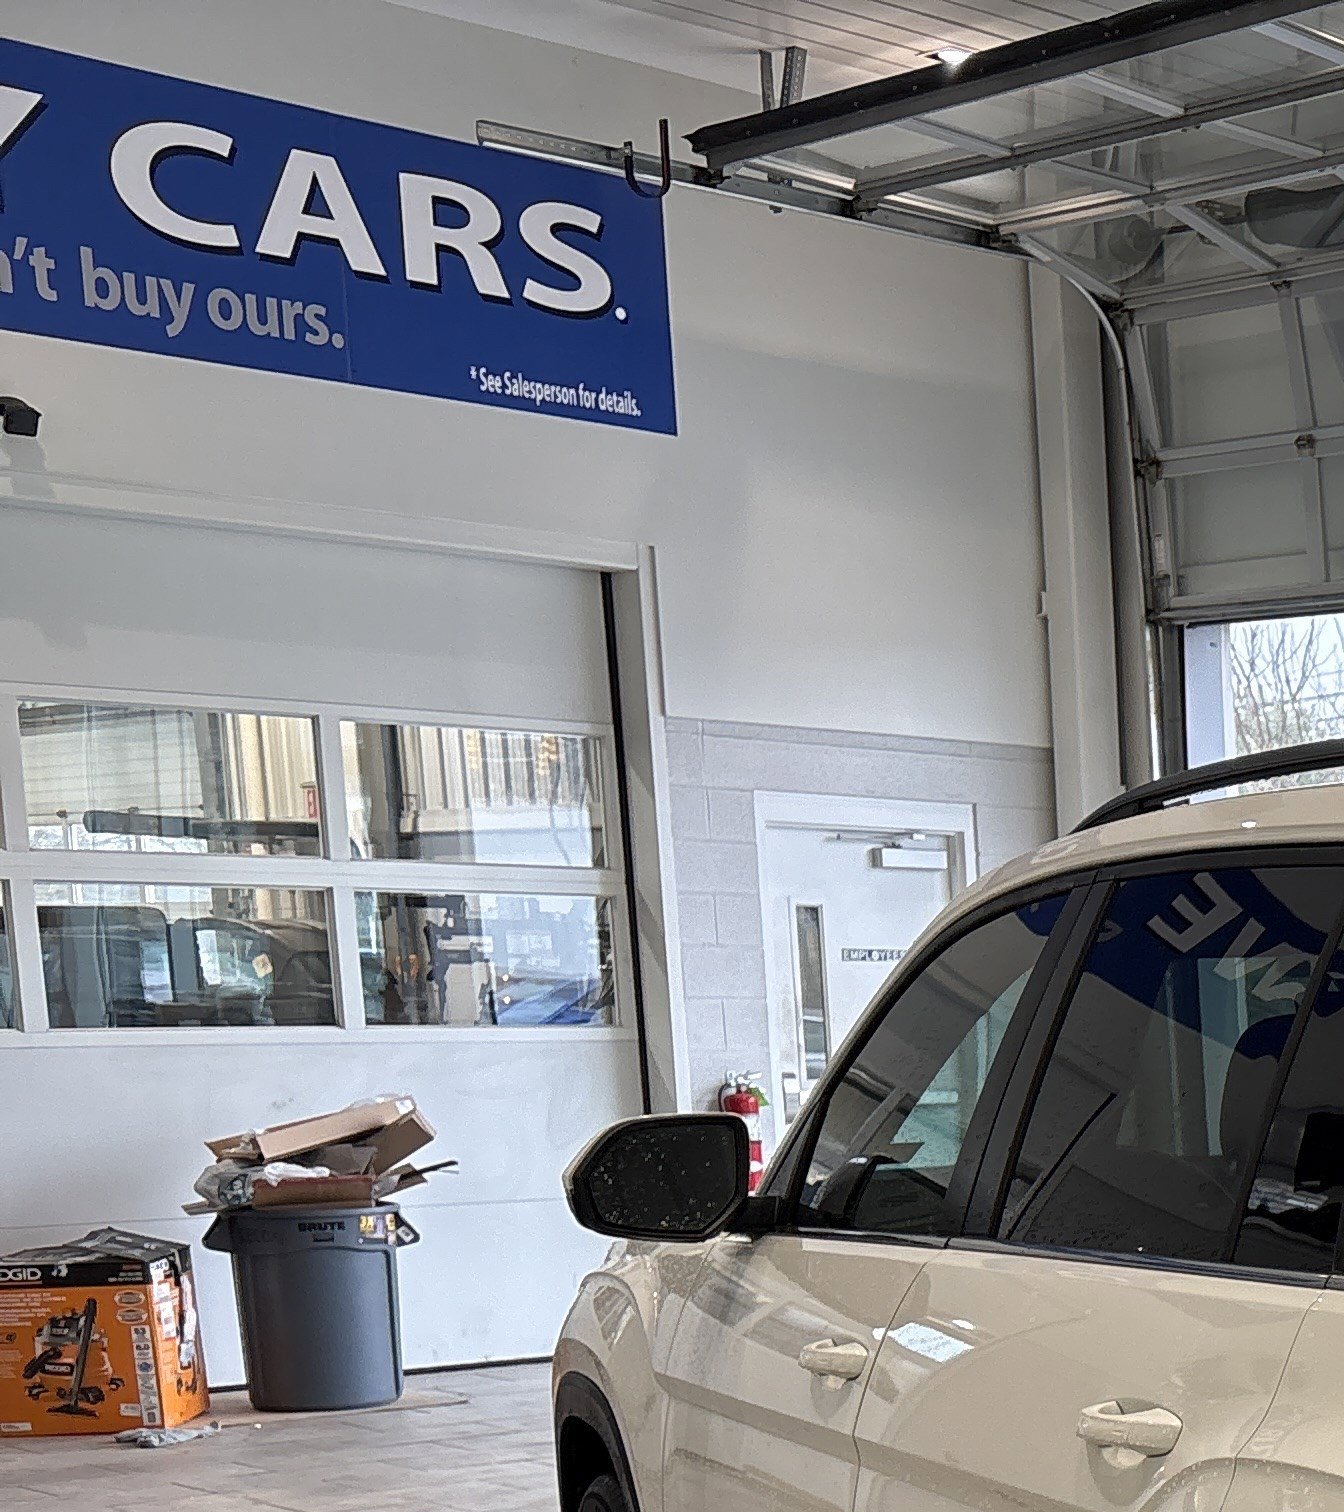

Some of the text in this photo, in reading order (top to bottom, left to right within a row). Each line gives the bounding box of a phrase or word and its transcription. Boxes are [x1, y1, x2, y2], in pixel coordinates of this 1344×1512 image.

[109, 120, 628, 322] CARS.
[79, 245, 195, 338] buy
[206, 287, 345, 349] ours.
[503, 371, 577, 406] Salesperson
[578, 382, 597, 409] for
[598, 386, 642, 417] details.
[297, 1220, 346, 1232] BRUTE
